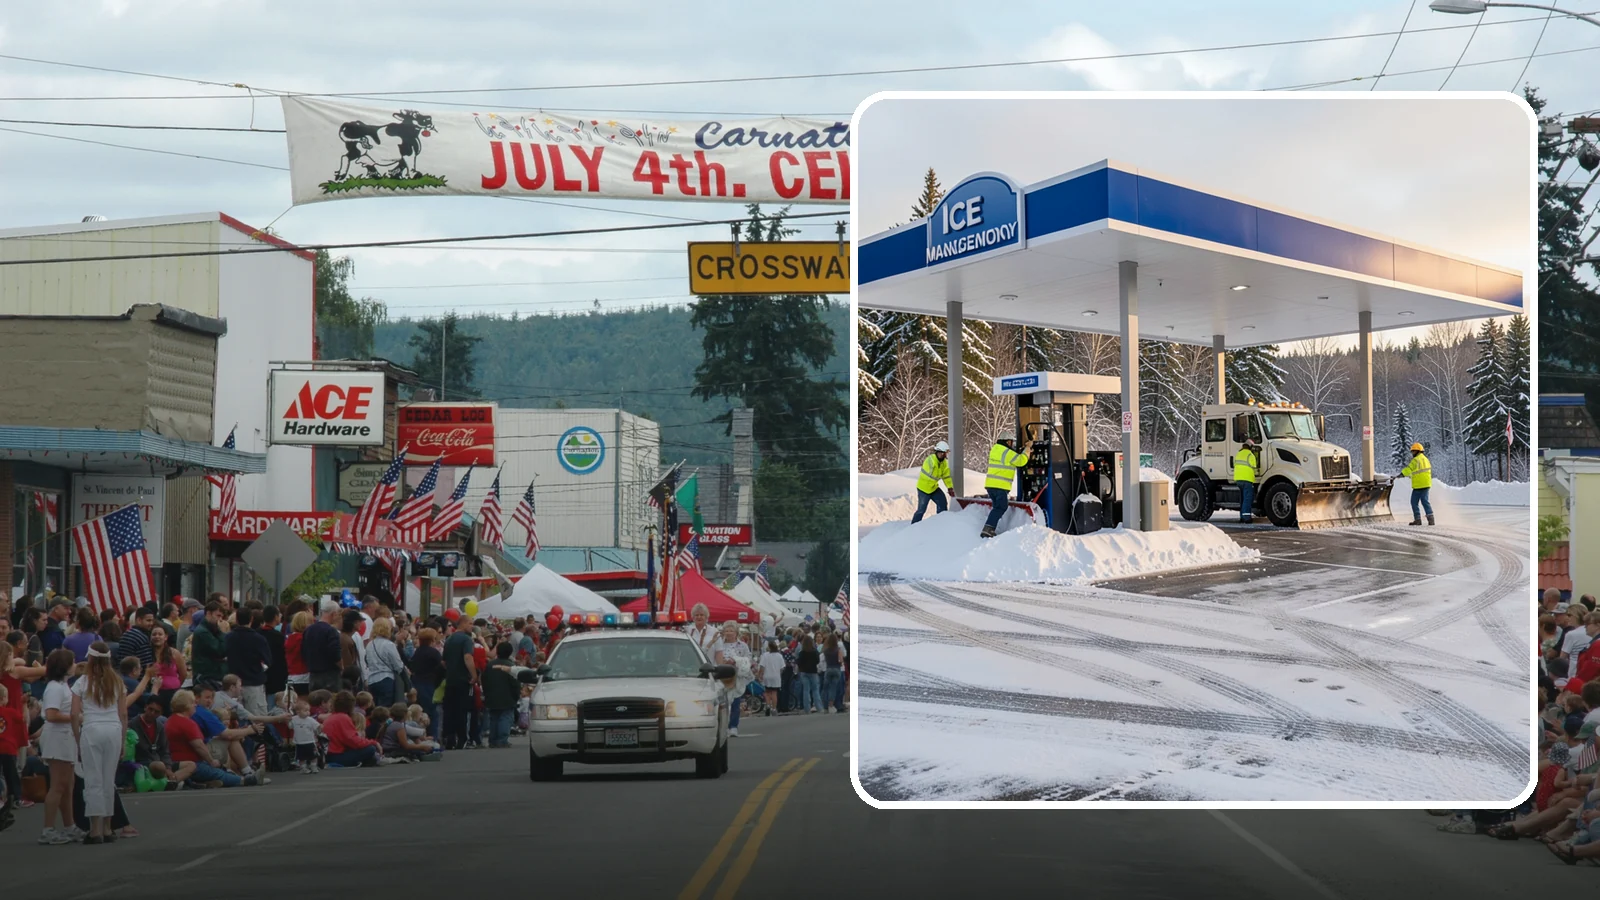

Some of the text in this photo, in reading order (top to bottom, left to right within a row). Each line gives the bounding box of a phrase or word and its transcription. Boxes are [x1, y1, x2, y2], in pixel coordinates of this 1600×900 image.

[695, 121, 850, 150] Carnat
[481, 140, 606, 192] JULY
[632, 150, 746, 198] 4th.
[942, 195, 982, 235] ICE
[697, 254, 850, 280] CROSSWA
[282, 380, 374, 420] ACE
[405, 409, 486, 422] CEDAR LOG
[283, 421, 371, 437] Hardware
[416, 428, 477, 447] Coca-Cola
[353, 467, 384, 481] Simpl
[83, 484, 155, 496] St. Vincent de Paul
[688, 526, 741, 535] CRNATION
[699, 535, 730, 543] GLASS
